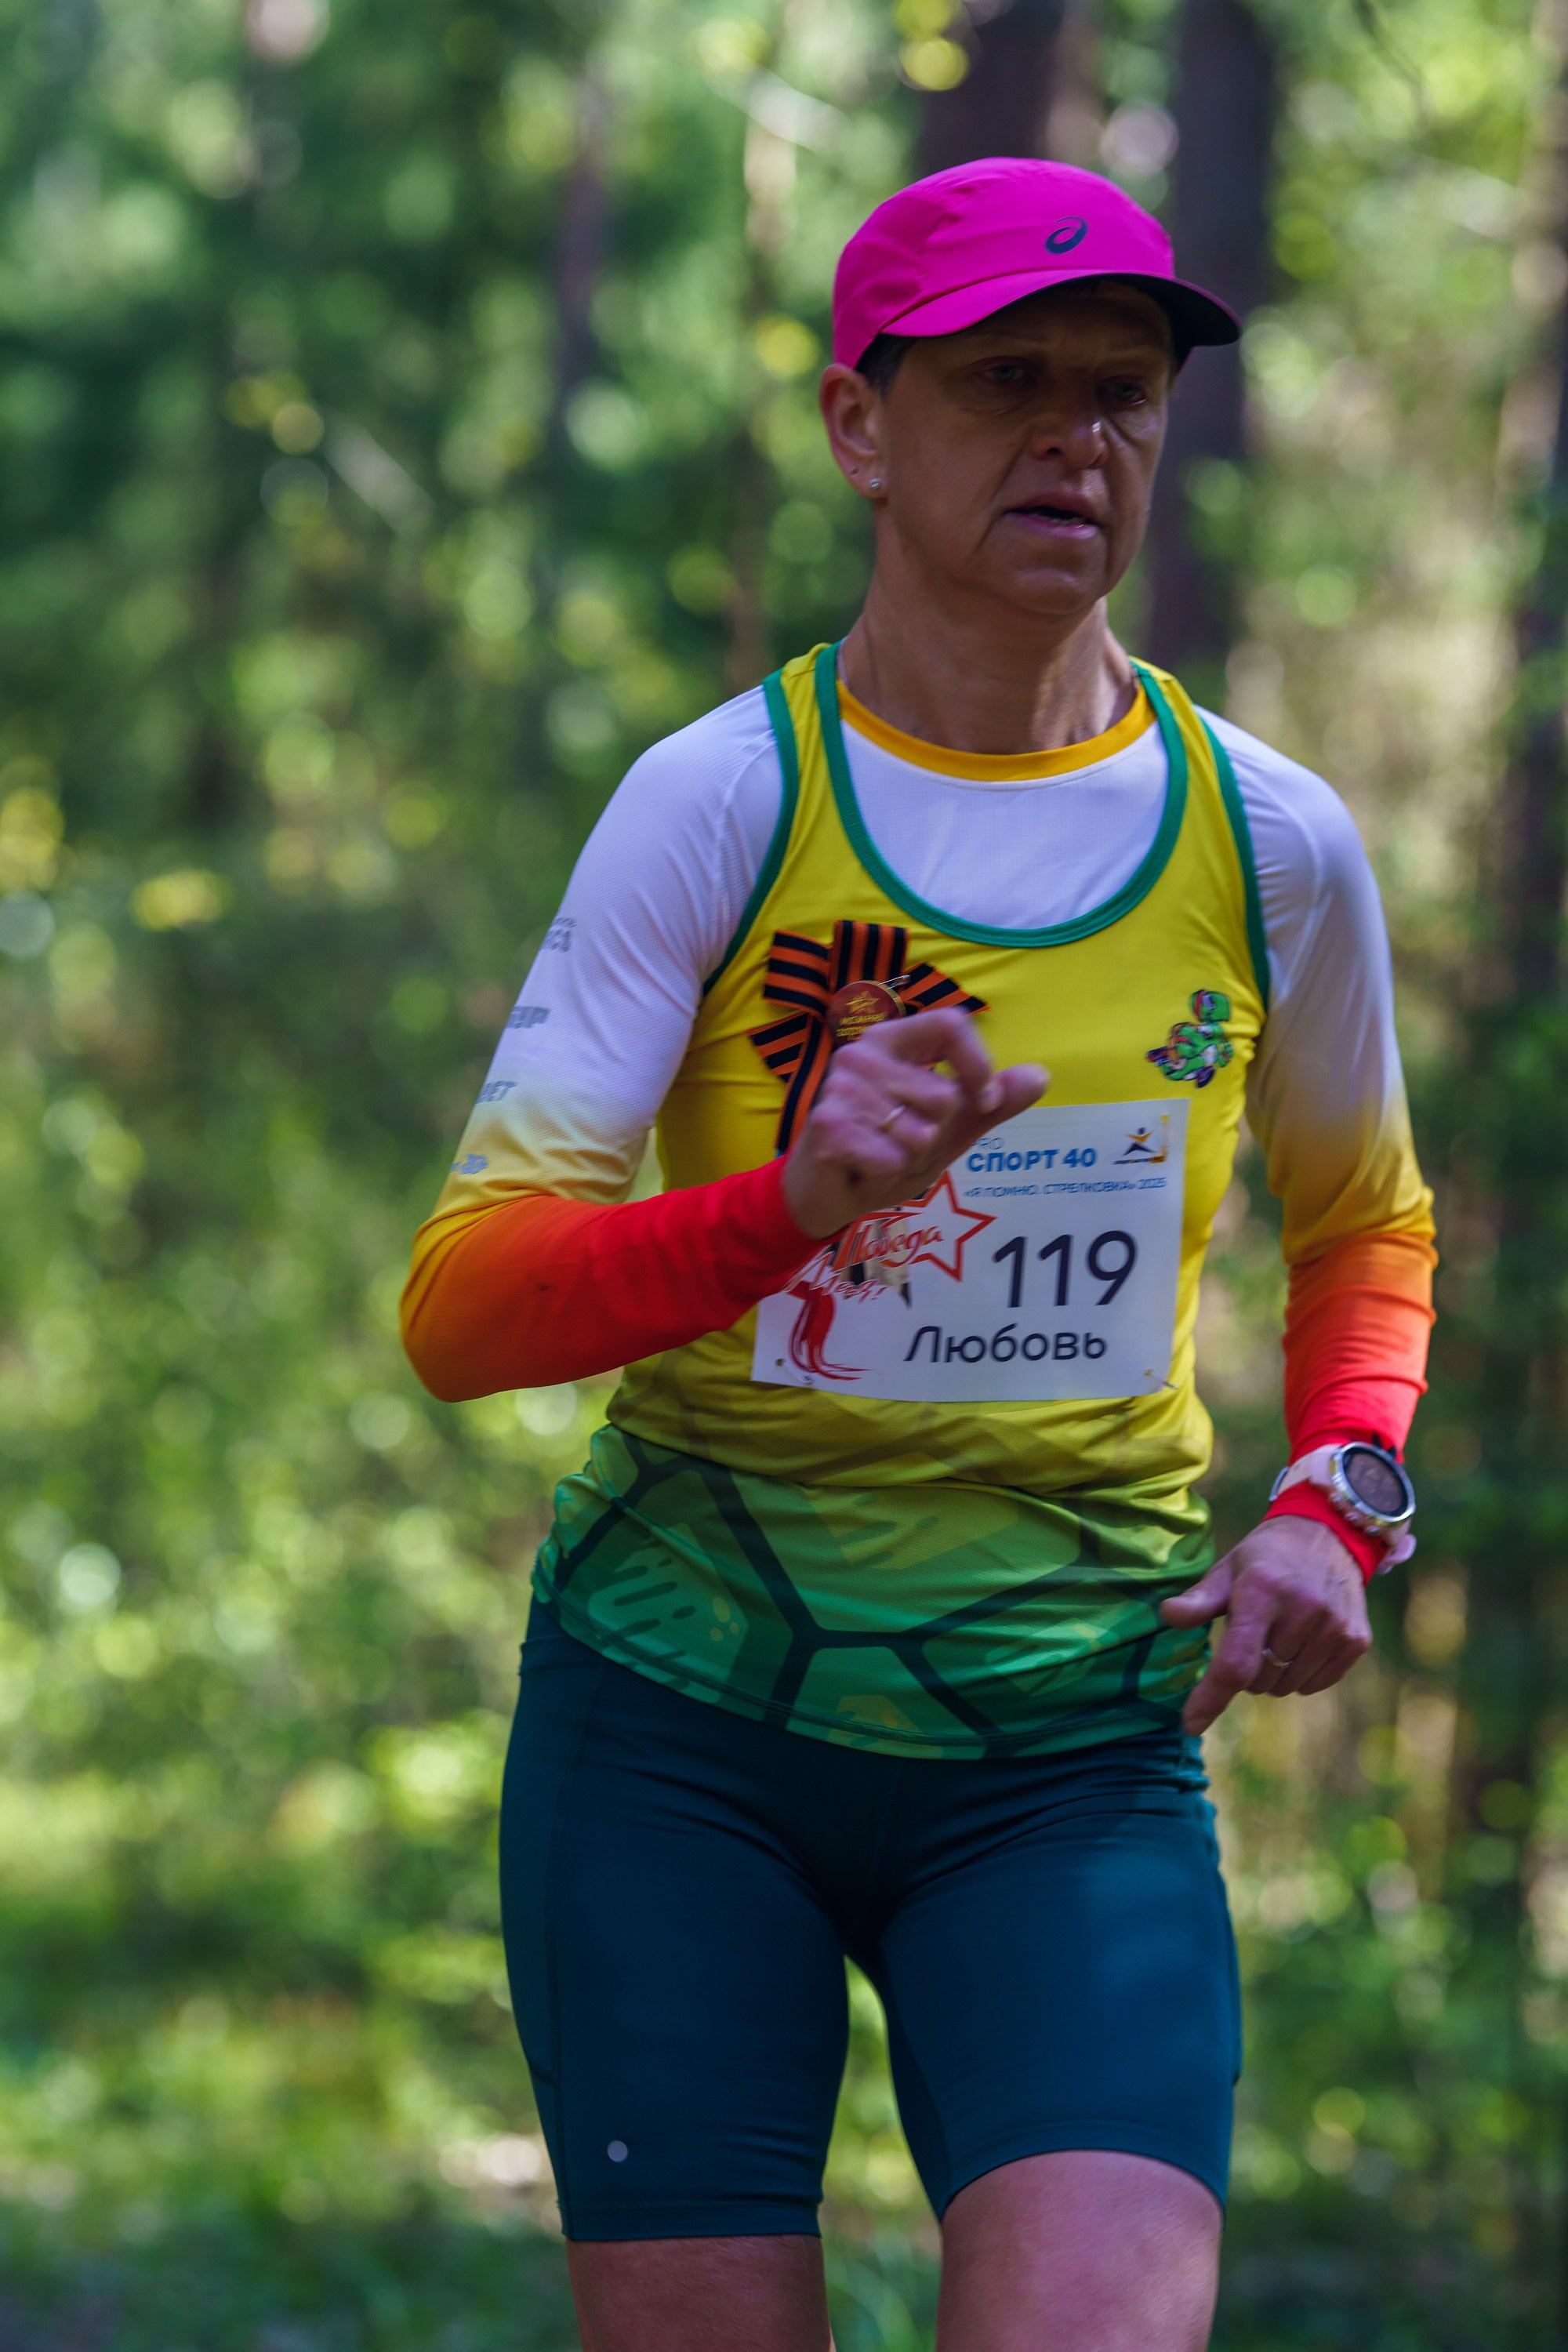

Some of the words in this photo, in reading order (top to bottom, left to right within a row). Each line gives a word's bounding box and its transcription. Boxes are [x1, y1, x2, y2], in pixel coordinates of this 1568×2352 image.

[966, 1149, 1058, 1173] СПОРТ
[1062, 1148, 1098, 1168] 40
[1137, 1177, 1167, 1190] 2025
[993, 1229, 1138, 1308] 119
[904, 1323, 1107, 1364] Любовь
